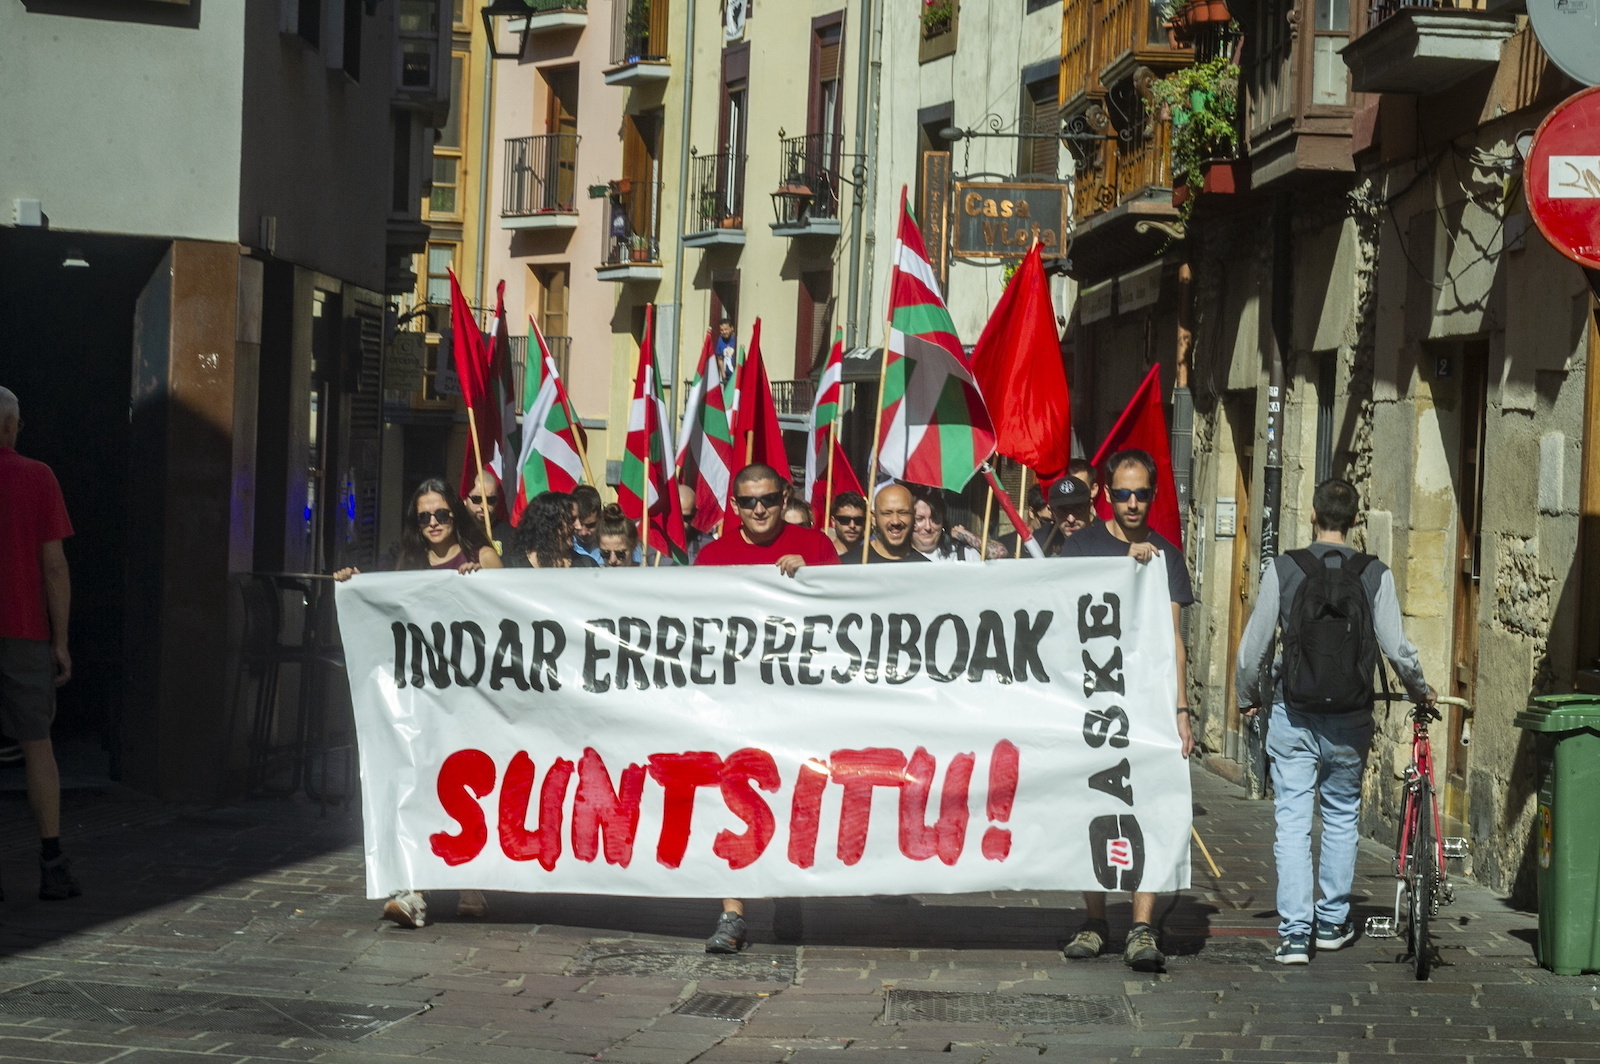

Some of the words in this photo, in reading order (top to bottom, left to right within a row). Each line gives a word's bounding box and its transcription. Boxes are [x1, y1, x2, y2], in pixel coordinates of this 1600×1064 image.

[965, 192, 1031, 218] Casa
[1438, 358, 1447, 376] 2
[391, 618, 566, 692] INDAR
[583, 609, 1053, 693] ERREPRESIBOAK
[429, 739, 1020, 872] SUNTSITU!
